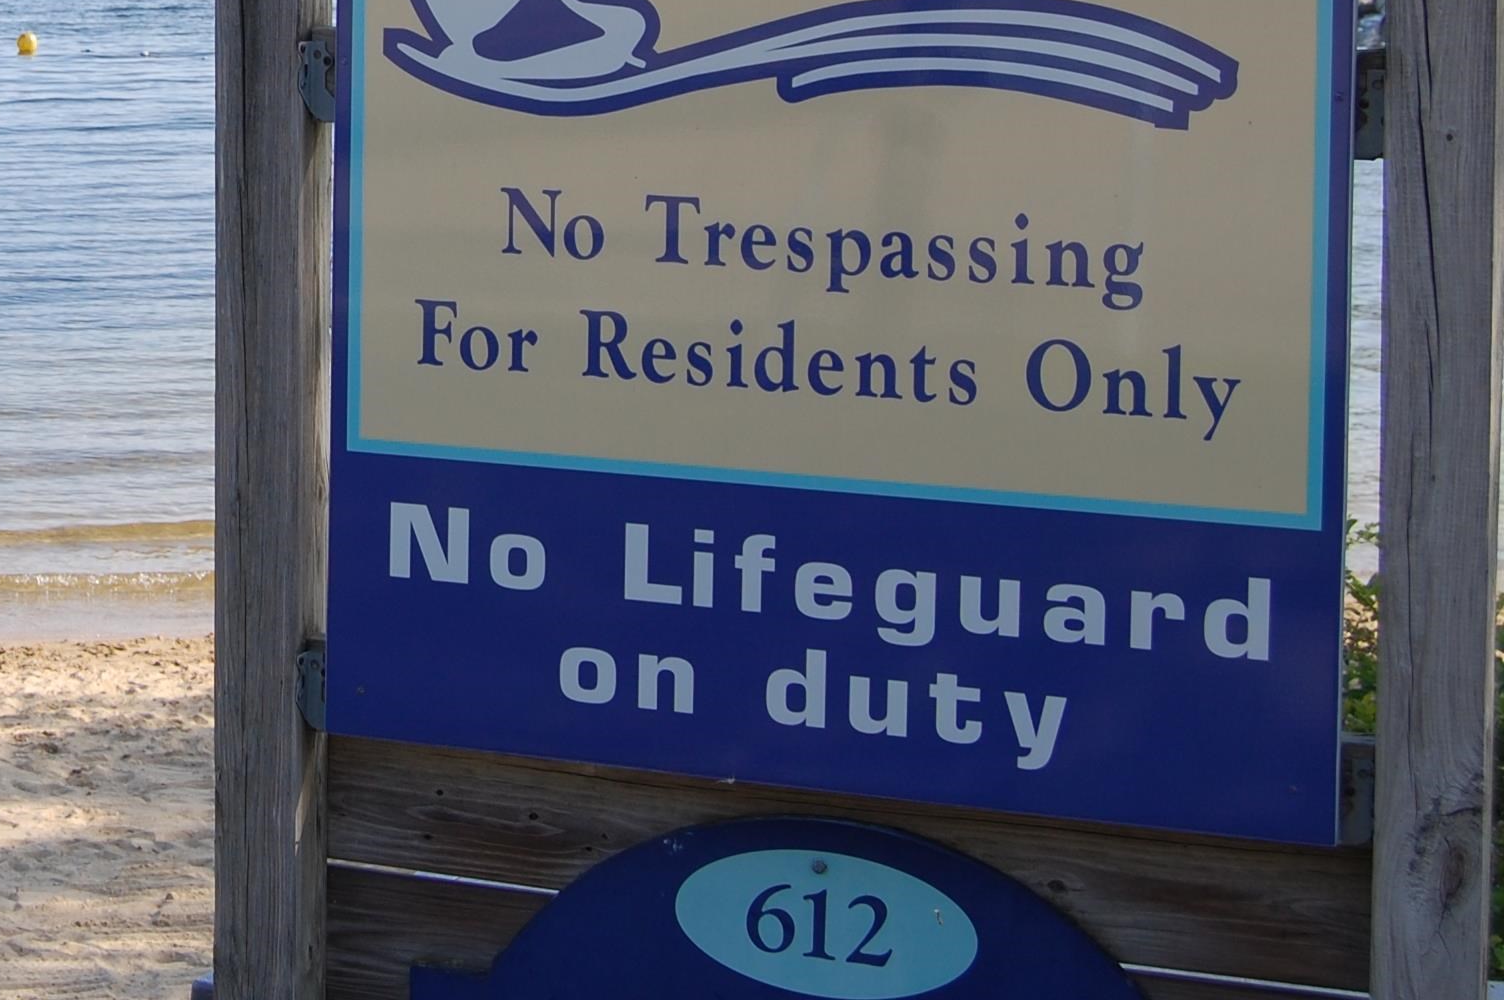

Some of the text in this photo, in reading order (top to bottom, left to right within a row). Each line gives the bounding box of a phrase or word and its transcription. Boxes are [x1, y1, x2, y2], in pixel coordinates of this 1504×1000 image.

[500, 186, 1144, 311] No Trespassing
[414, 298, 1243, 442] For Residents Only
[388, 501, 1272, 662] No Lifeguard
[559, 646, 1068, 771] on duty
[745, 883, 894, 969] 612
